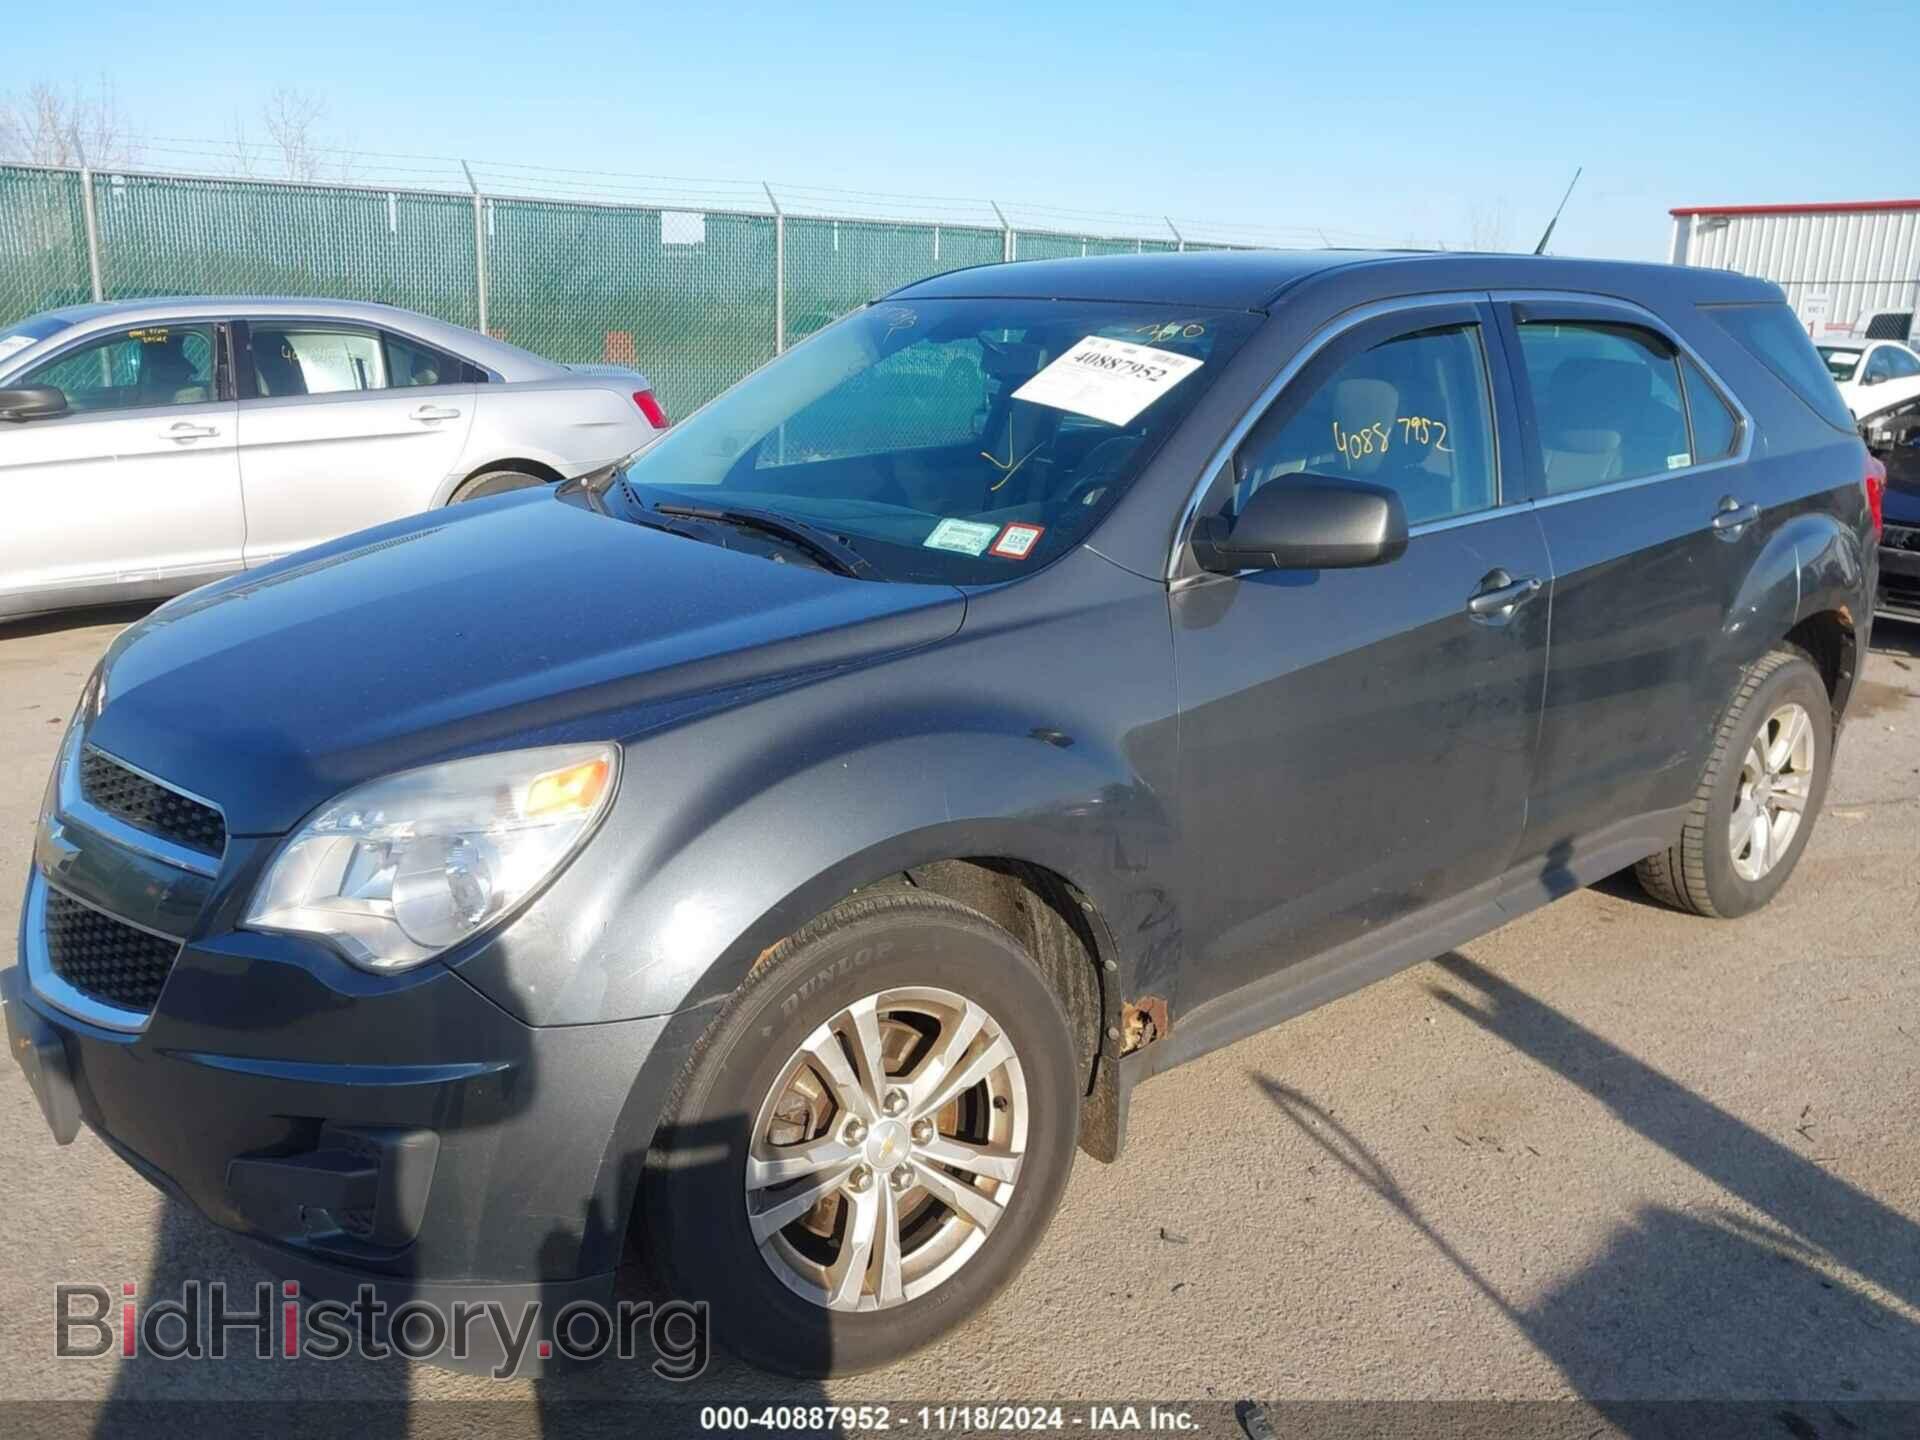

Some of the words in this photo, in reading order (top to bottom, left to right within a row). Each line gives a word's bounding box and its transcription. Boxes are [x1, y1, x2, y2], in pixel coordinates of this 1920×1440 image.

[1074, 350, 1168, 382] 40887952
[1333, 421, 1392, 470] 4088
[1397, 416, 1454, 452] 7952
[780, 942, 895, 1016] DUNLOP
